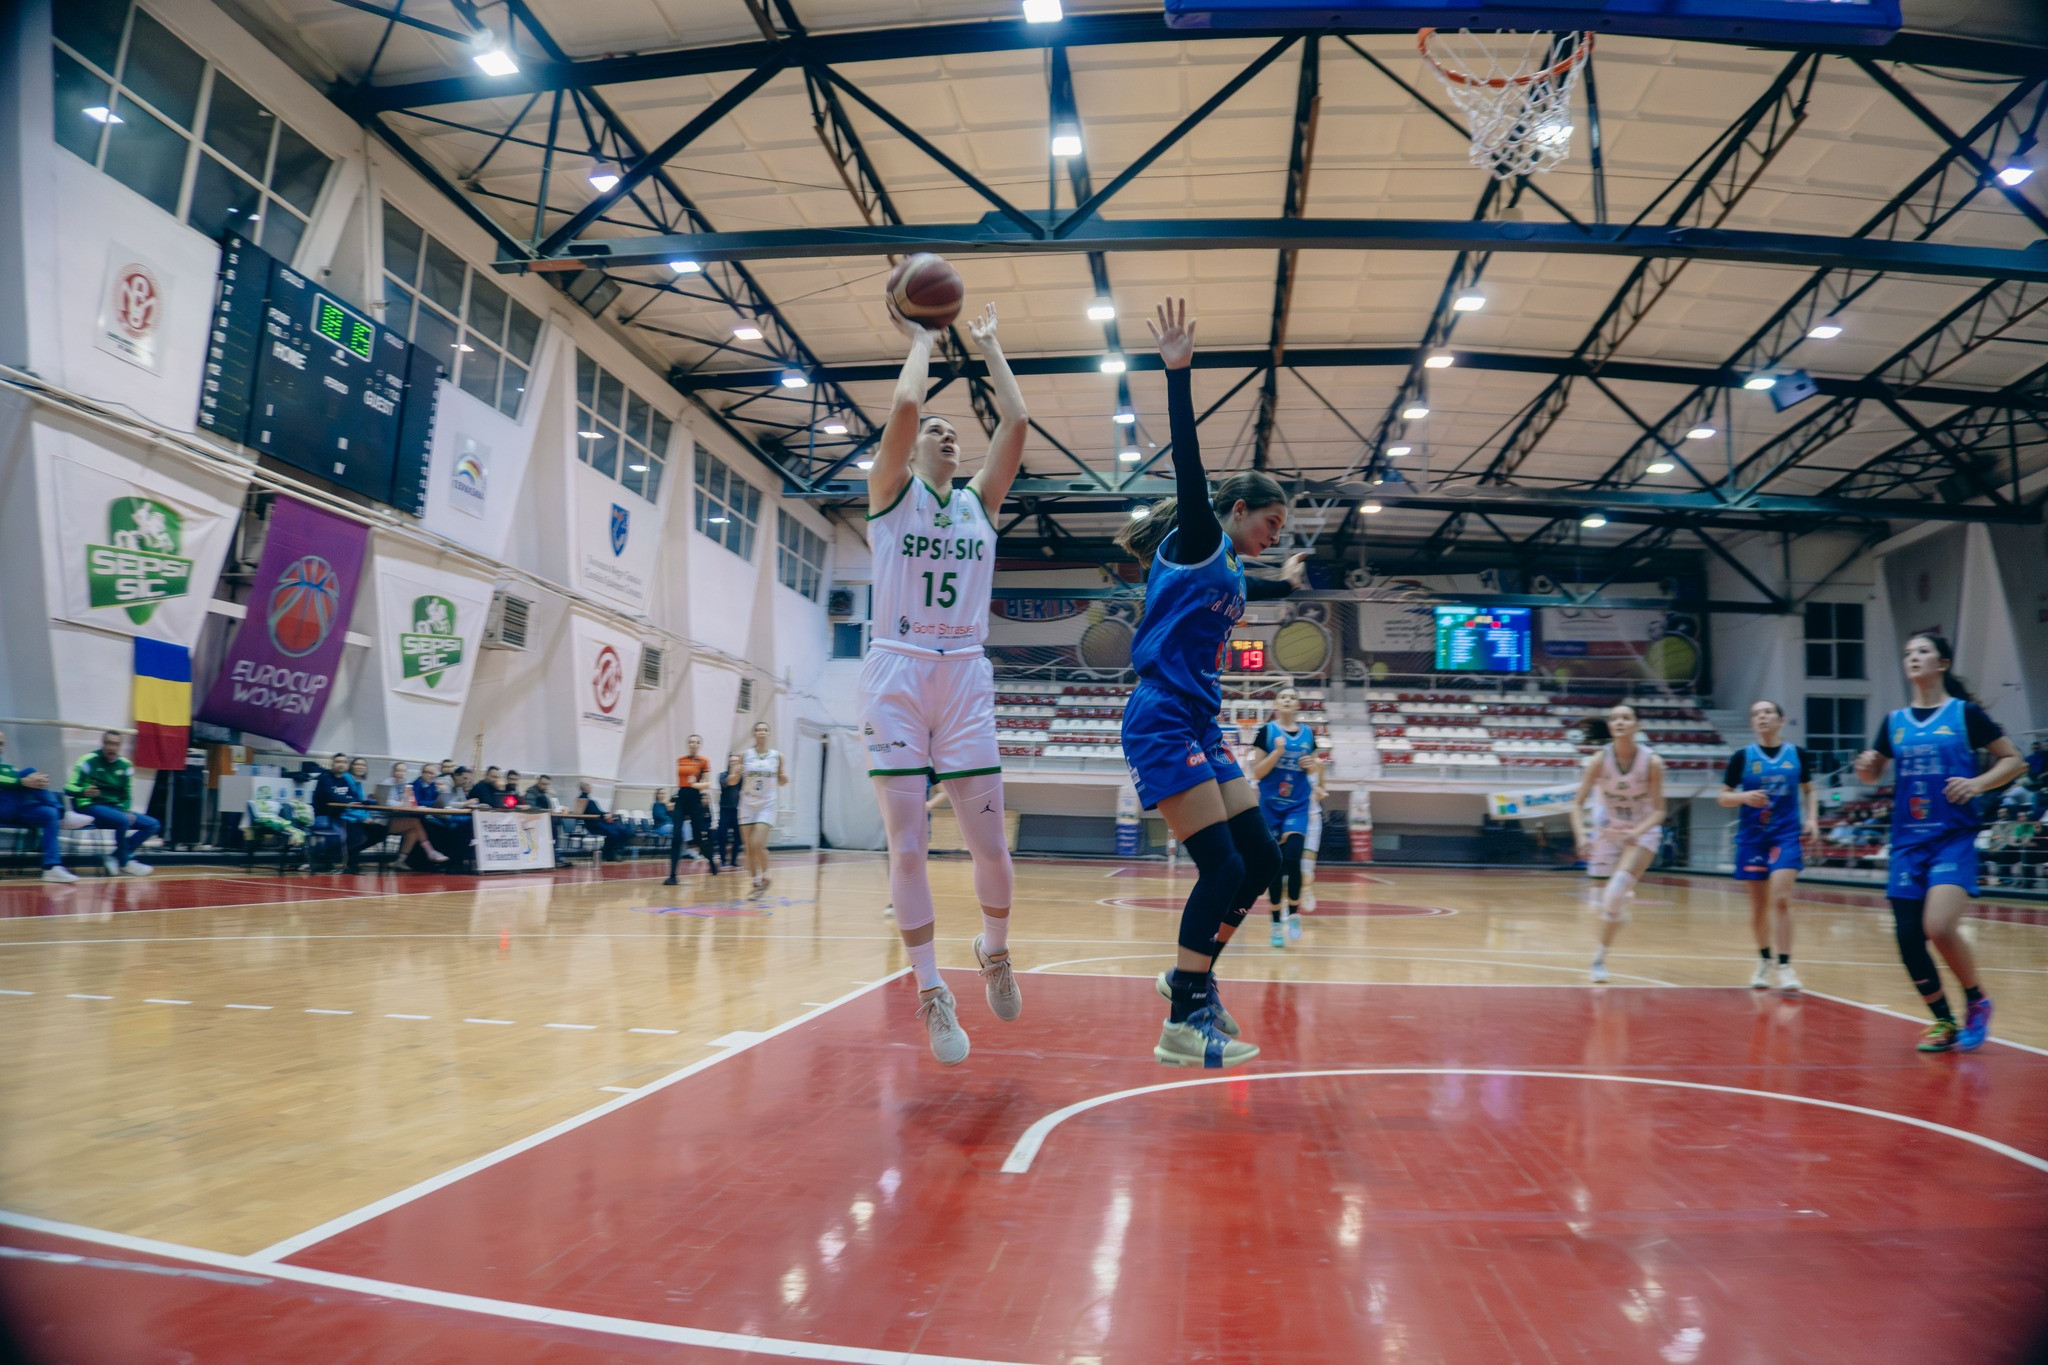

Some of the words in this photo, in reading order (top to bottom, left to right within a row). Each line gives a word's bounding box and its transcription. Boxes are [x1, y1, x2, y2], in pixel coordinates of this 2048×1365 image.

[272, 341, 308, 370] HOME
[363, 390, 395, 416] GUEST
[921, 571, 958, 608] 15
[1241, 651, 1264, 669] 19
[230, 660, 329, 695] EUROCUP
[232, 683, 315, 714] WOMEN
